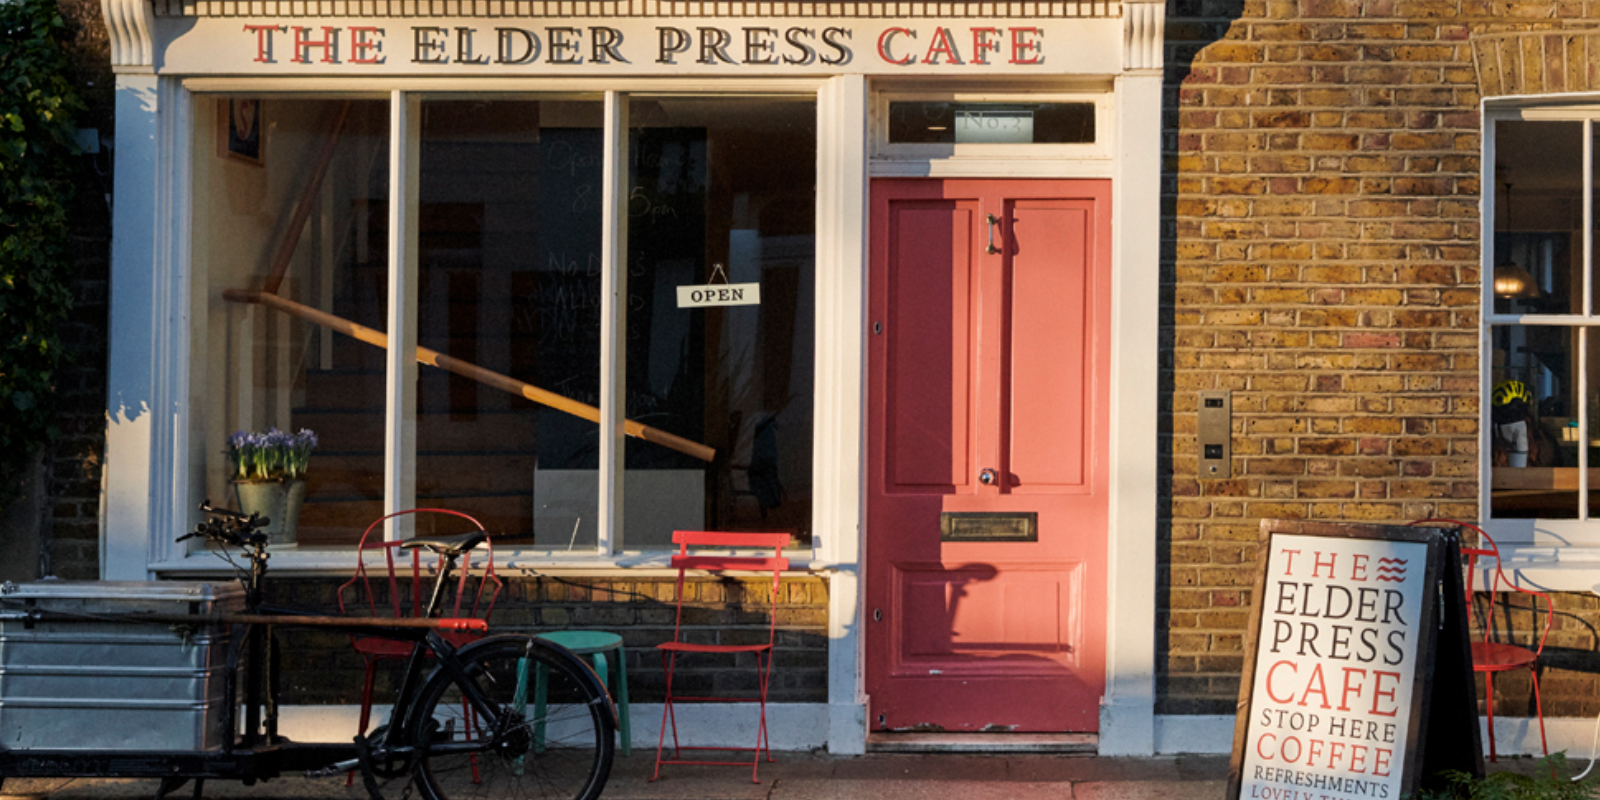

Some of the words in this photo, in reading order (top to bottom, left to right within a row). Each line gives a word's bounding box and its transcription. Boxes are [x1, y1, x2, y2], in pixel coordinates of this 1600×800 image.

[243, 24, 387, 65] THE
[411, 26, 632, 65] ELDER
[655, 26, 854, 65] PRESS
[876, 26, 1047, 65] CAFE
[962, 110, 1022, 134] No.3
[690, 288, 745, 303] OPEN
[1280, 548, 1370, 582] THE
[1274, 580, 1408, 627] ELDER
[1270, 619, 1407, 666] PRESS
[1265, 660, 1402, 718] CAFE
[1260, 708, 1320, 733] STOP
[1328, 716, 1397, 744] HERE
[1256, 732, 1393, 778] COFFEE
[1250, 784, 1314, 800] LOVELY
[1253, 765, 1390, 799] REFRESHMENTS
